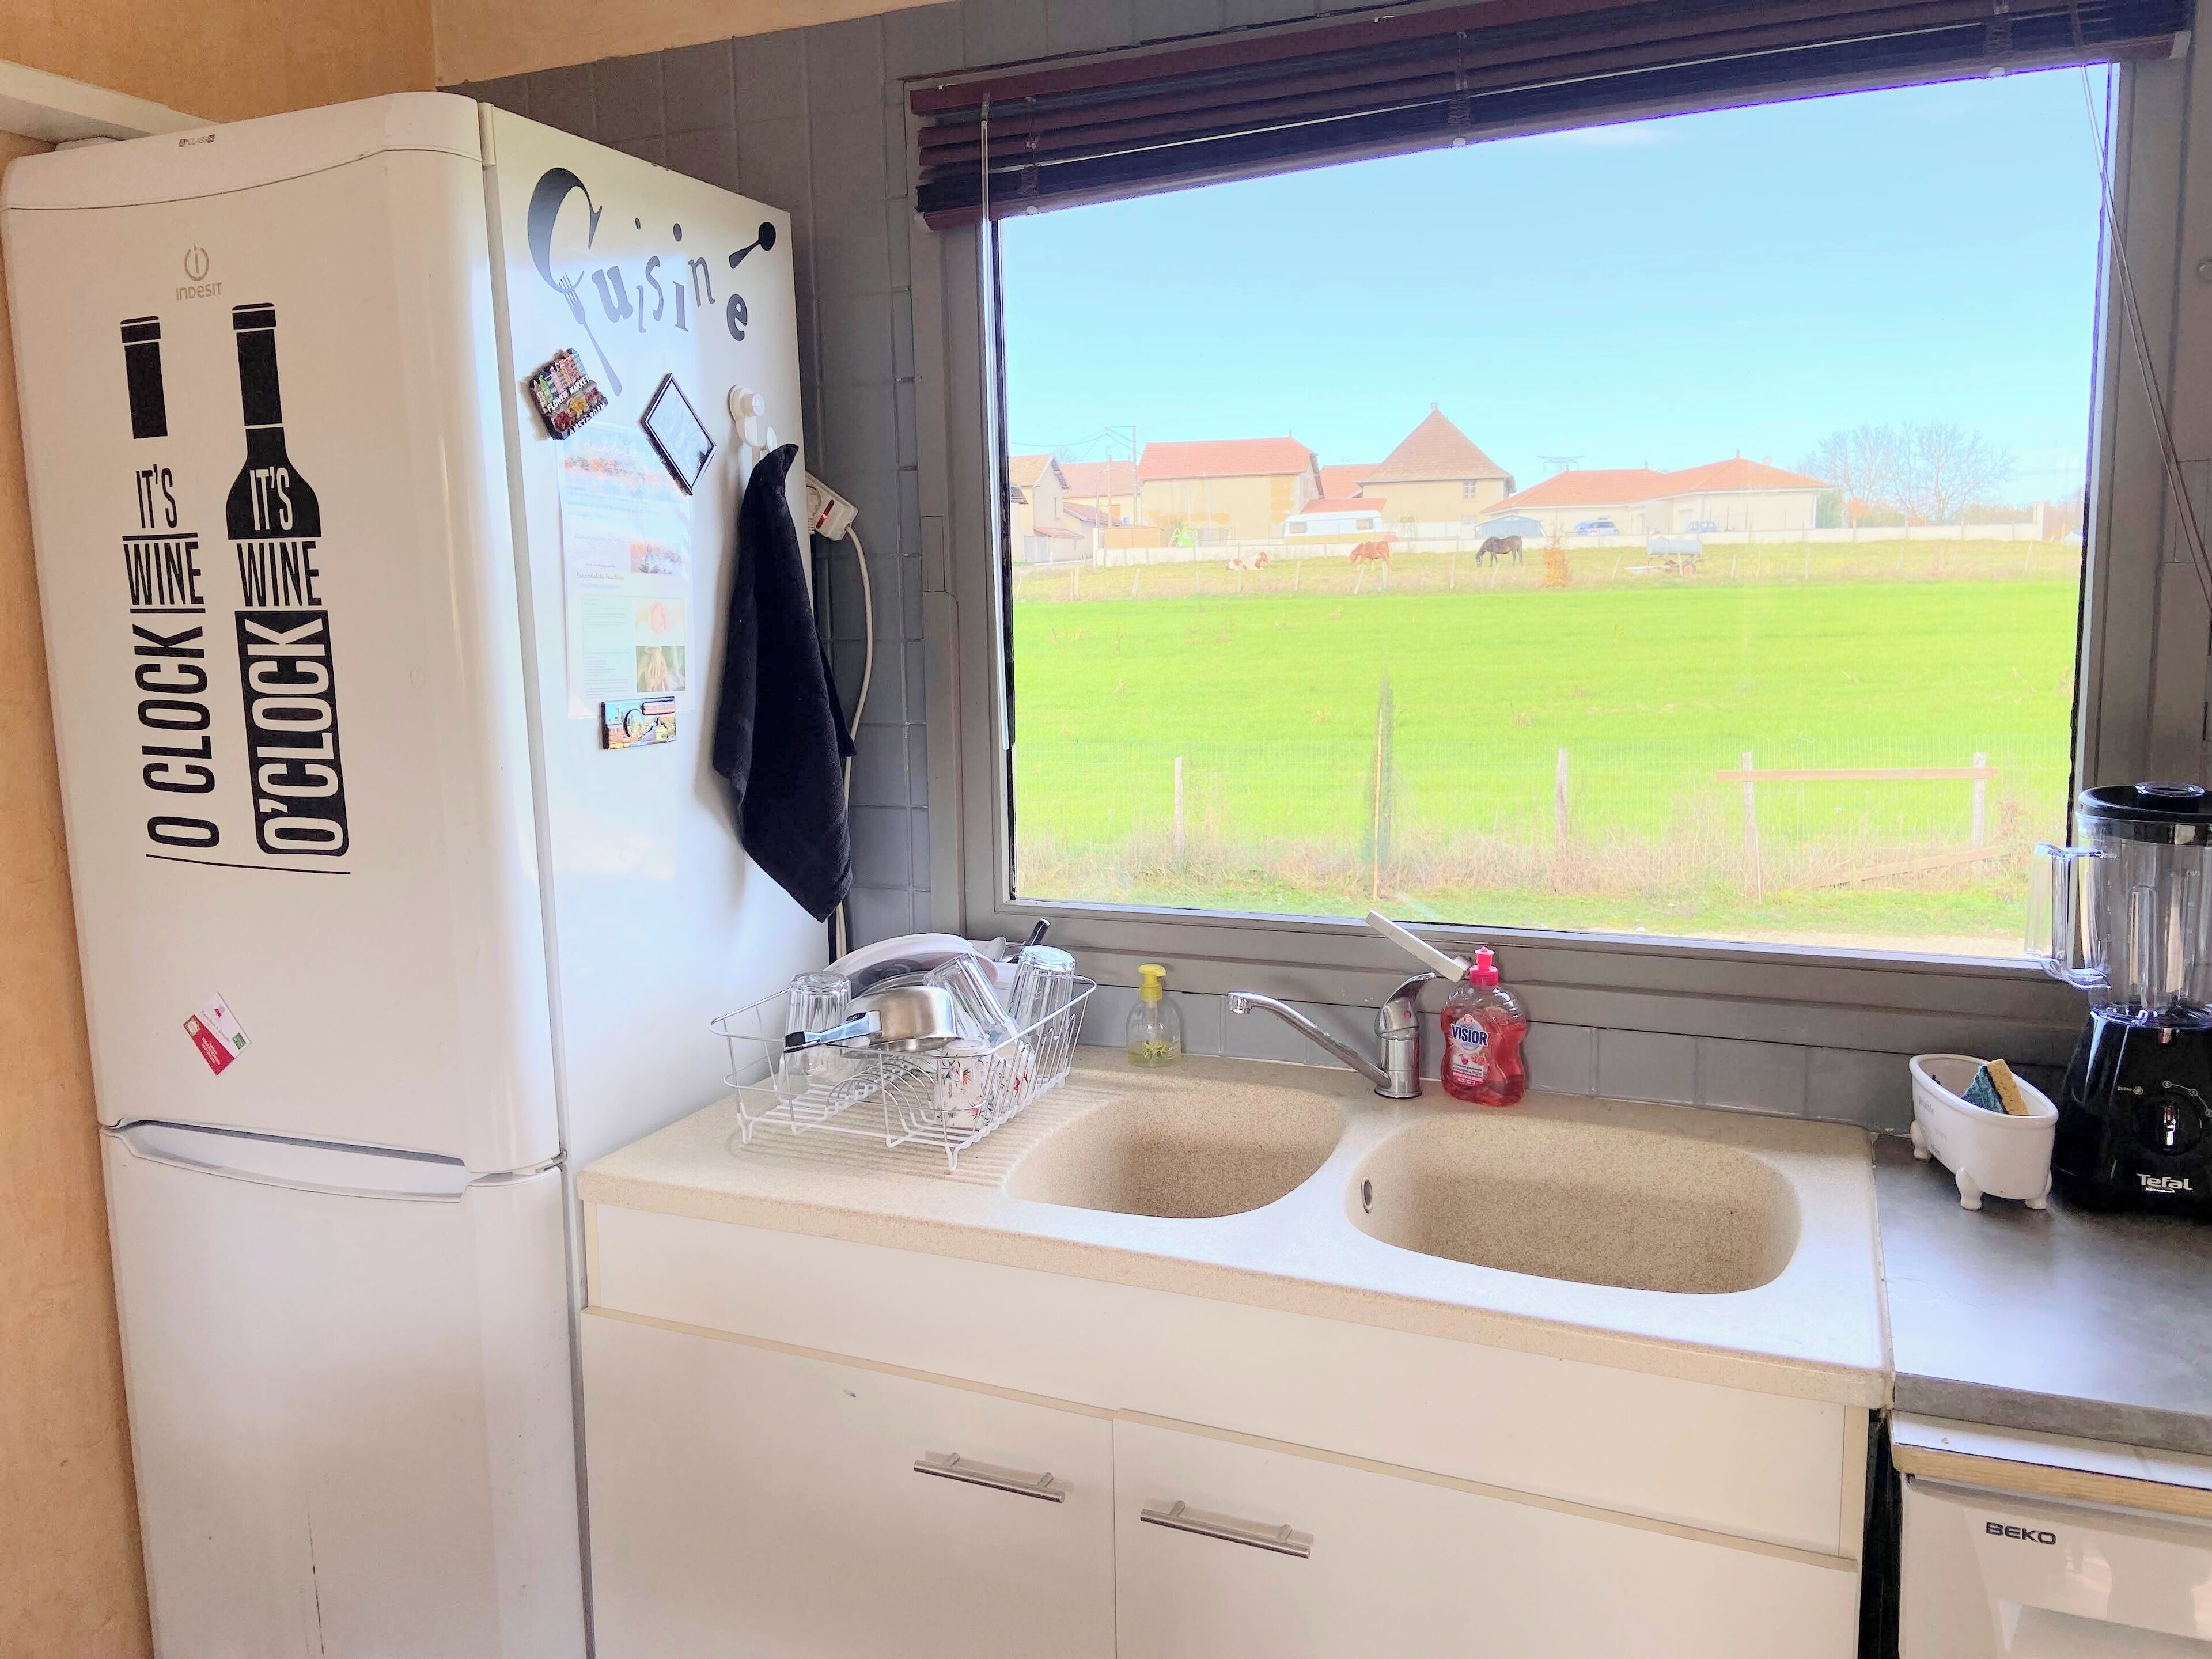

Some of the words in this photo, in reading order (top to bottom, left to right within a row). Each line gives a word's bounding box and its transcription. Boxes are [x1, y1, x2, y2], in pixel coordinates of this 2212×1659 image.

[547, 391, 569, 413] FLOWER
[569, 374, 590, 395] MARKET
[568, 402, 606, 435] AMSTERDAM
[249, 465, 293, 531] IT'S
[123, 541, 204, 605] WINE
[236, 540, 323, 607] WINE
[244, 617, 344, 851] O'CLOCK
[1451, 1025, 1488, 1046] VISIOR
[2136, 1172, 2192, 1191] Tefal
[1986, 1522, 2056, 1545] BEKO
